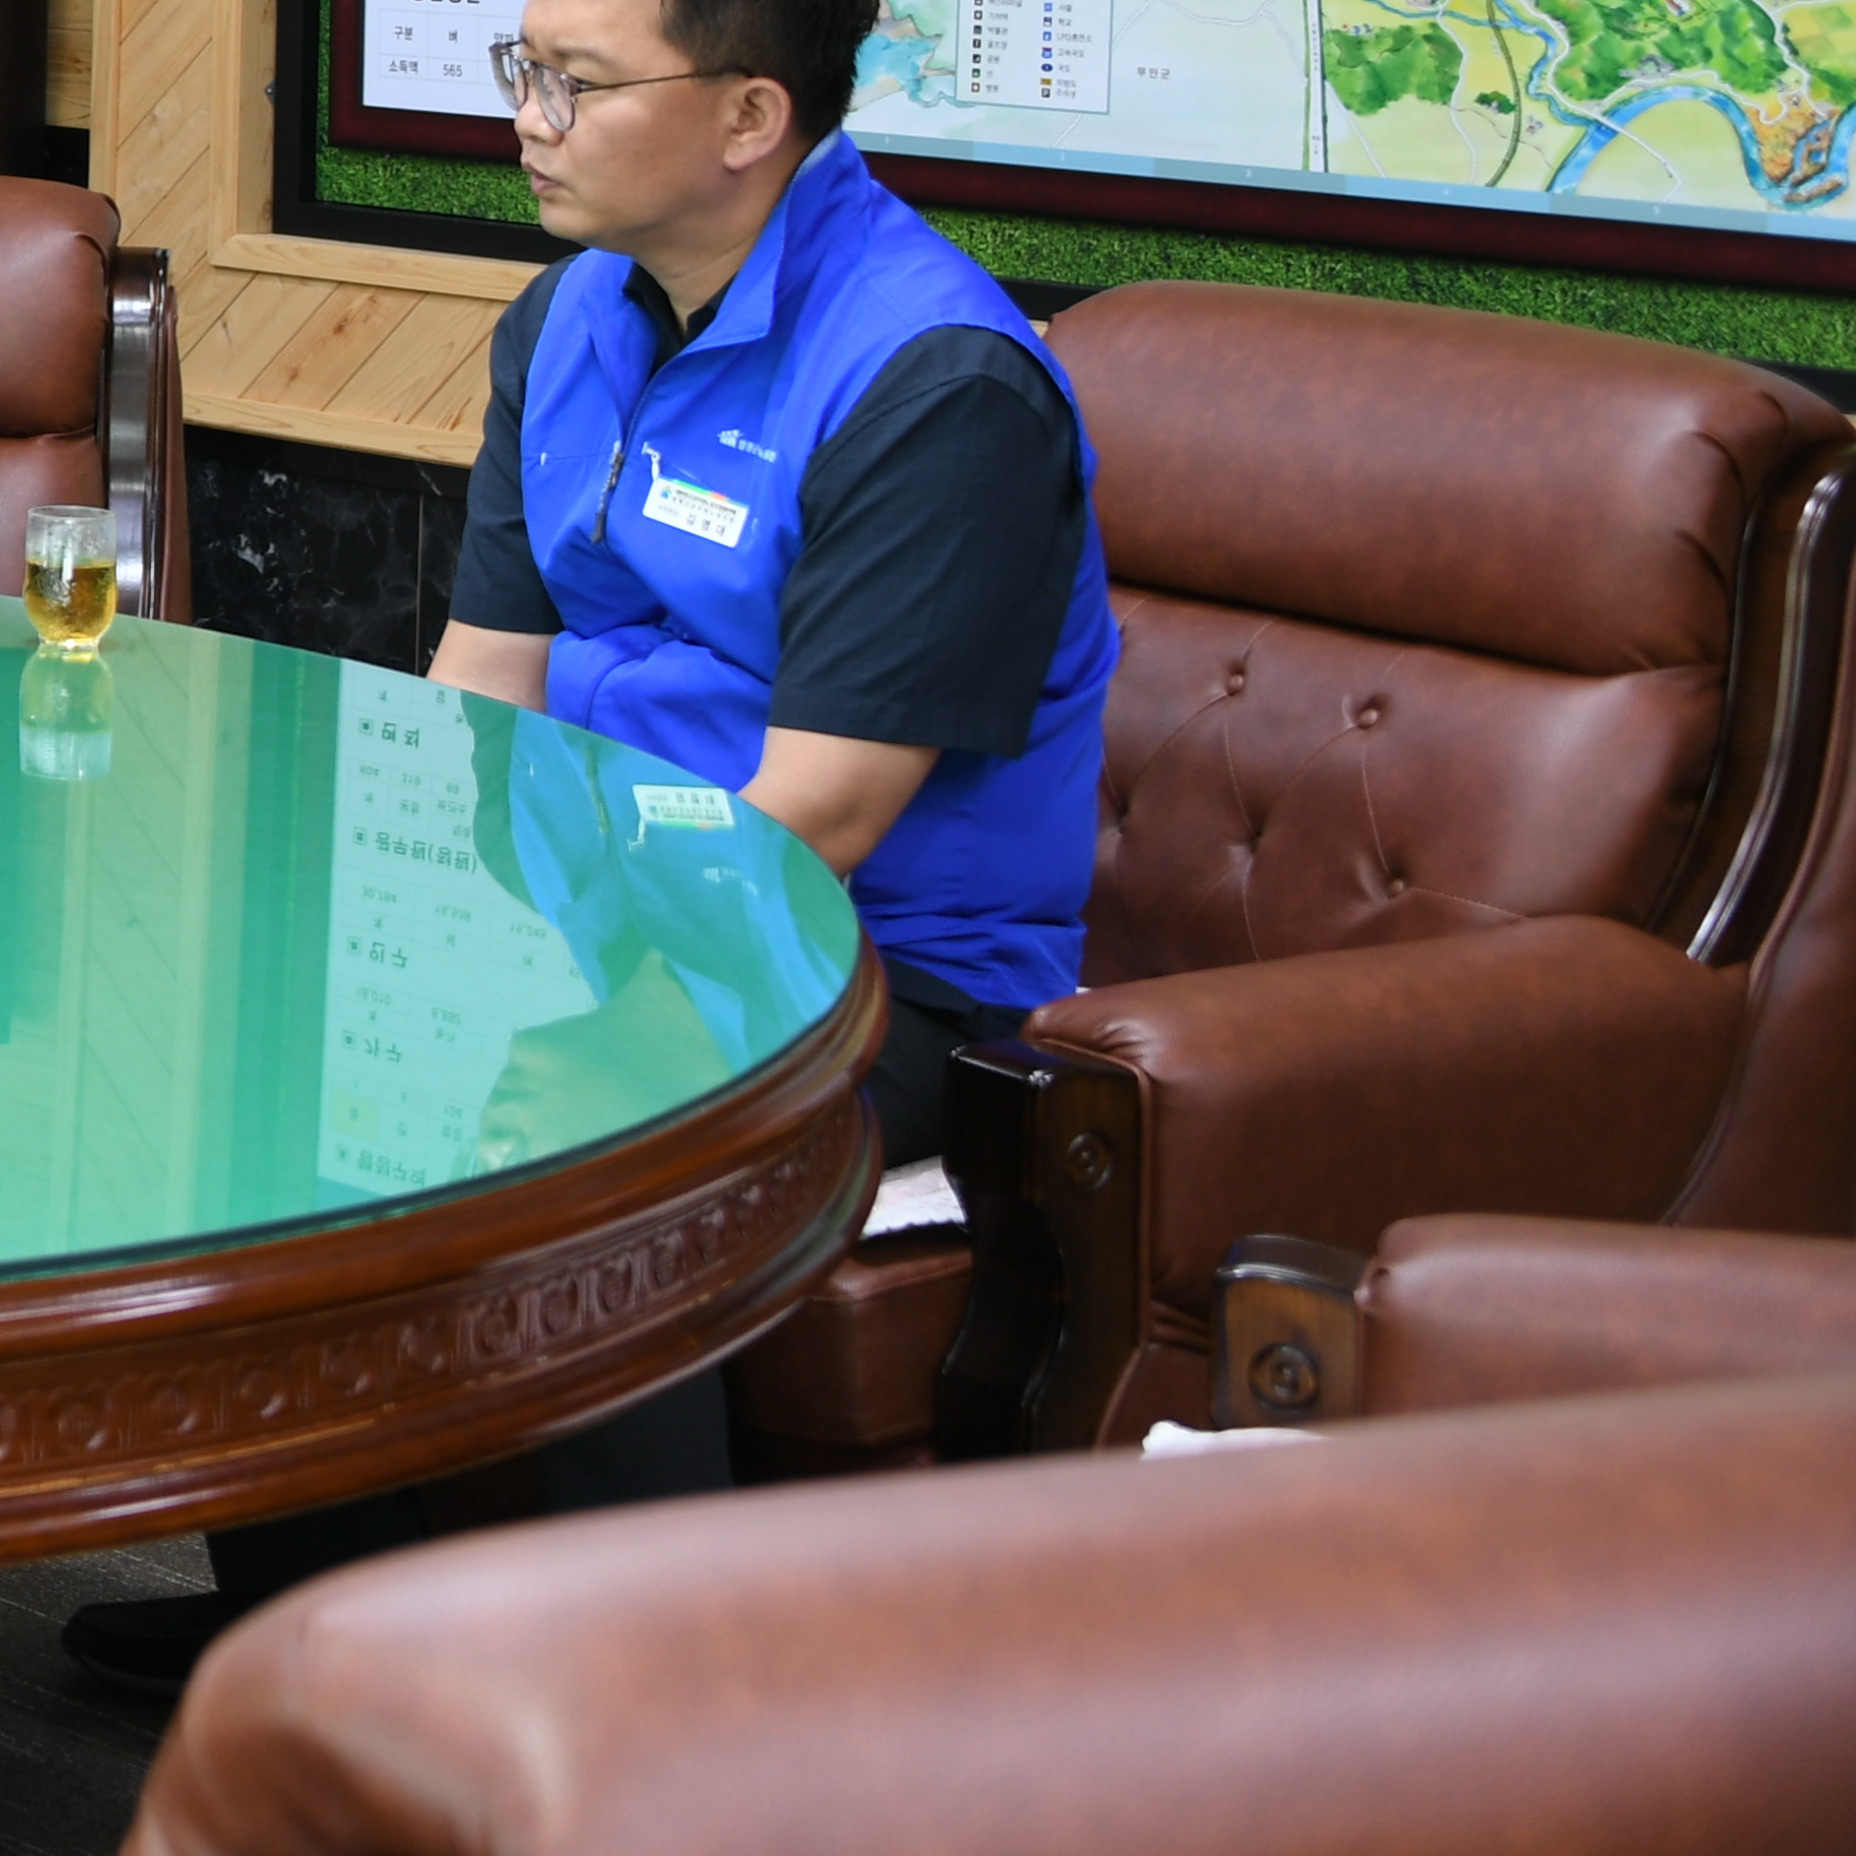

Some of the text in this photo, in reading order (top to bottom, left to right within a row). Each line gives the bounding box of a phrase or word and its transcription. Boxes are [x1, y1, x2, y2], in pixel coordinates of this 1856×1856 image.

[393, 25, 413, 41] 구분
[448, 30, 458, 43] 벼
[388, 59, 419, 75] 소득액
[442, 64, 462, 77] 565
[1137, 66, 1171, 80] 무안군
